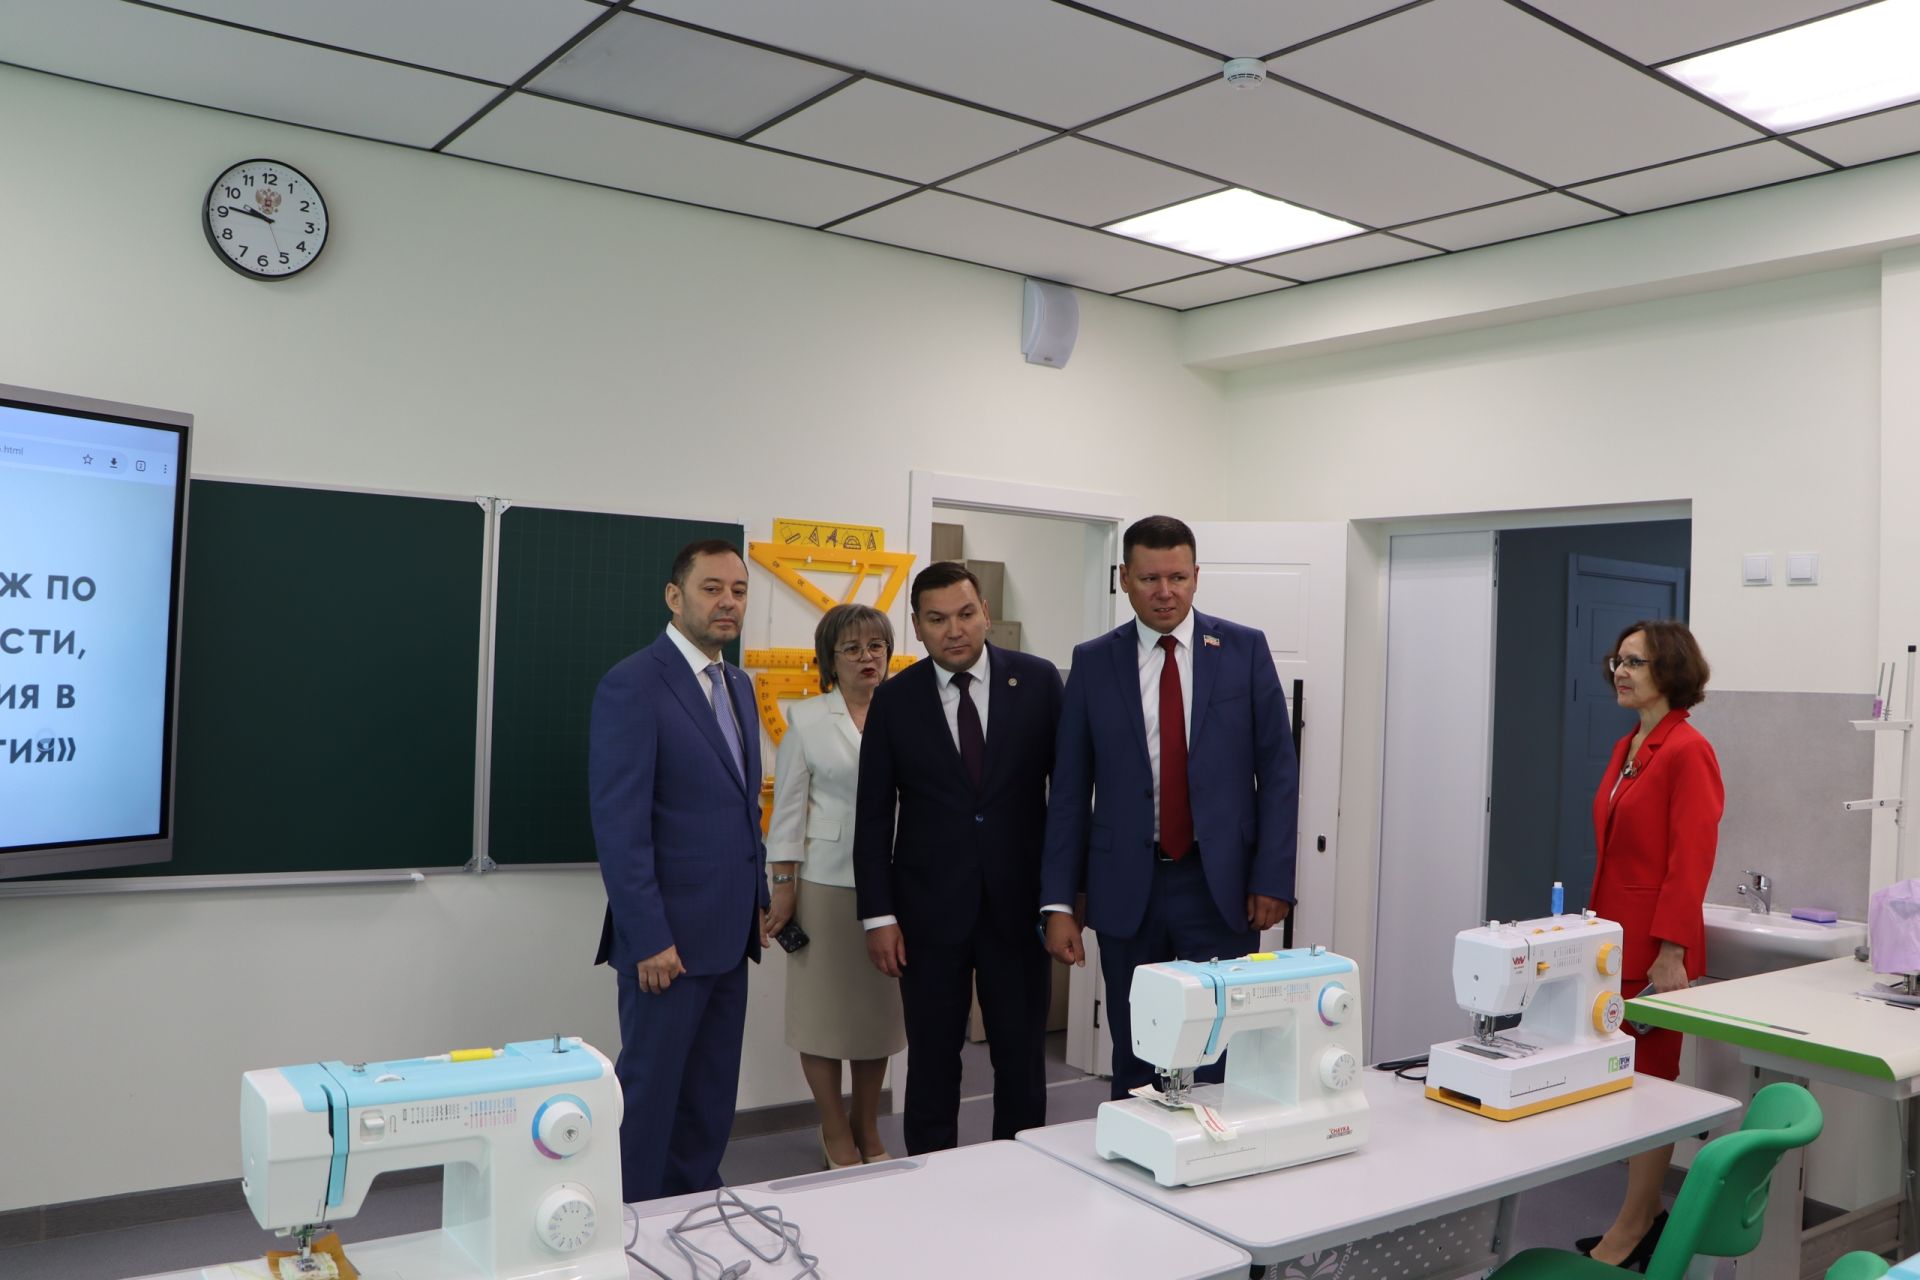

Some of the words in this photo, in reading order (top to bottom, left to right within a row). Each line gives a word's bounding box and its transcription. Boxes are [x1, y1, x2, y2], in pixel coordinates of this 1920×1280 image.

[242, 174, 255, 187] 11
[262, 172, 278, 186] 12
[225, 186, 242, 199] 10
[287, 182, 294, 194] 1
[217, 205, 229, 218] 9
[299, 200, 310, 213] 2
[221, 227, 233, 240] 8
[304, 221, 315, 234] 3
[238, 244, 249, 258] 7
[295, 240, 307, 253] 4
[257, 254, 269, 267] 6
[278, 251, 290, 265] 5
